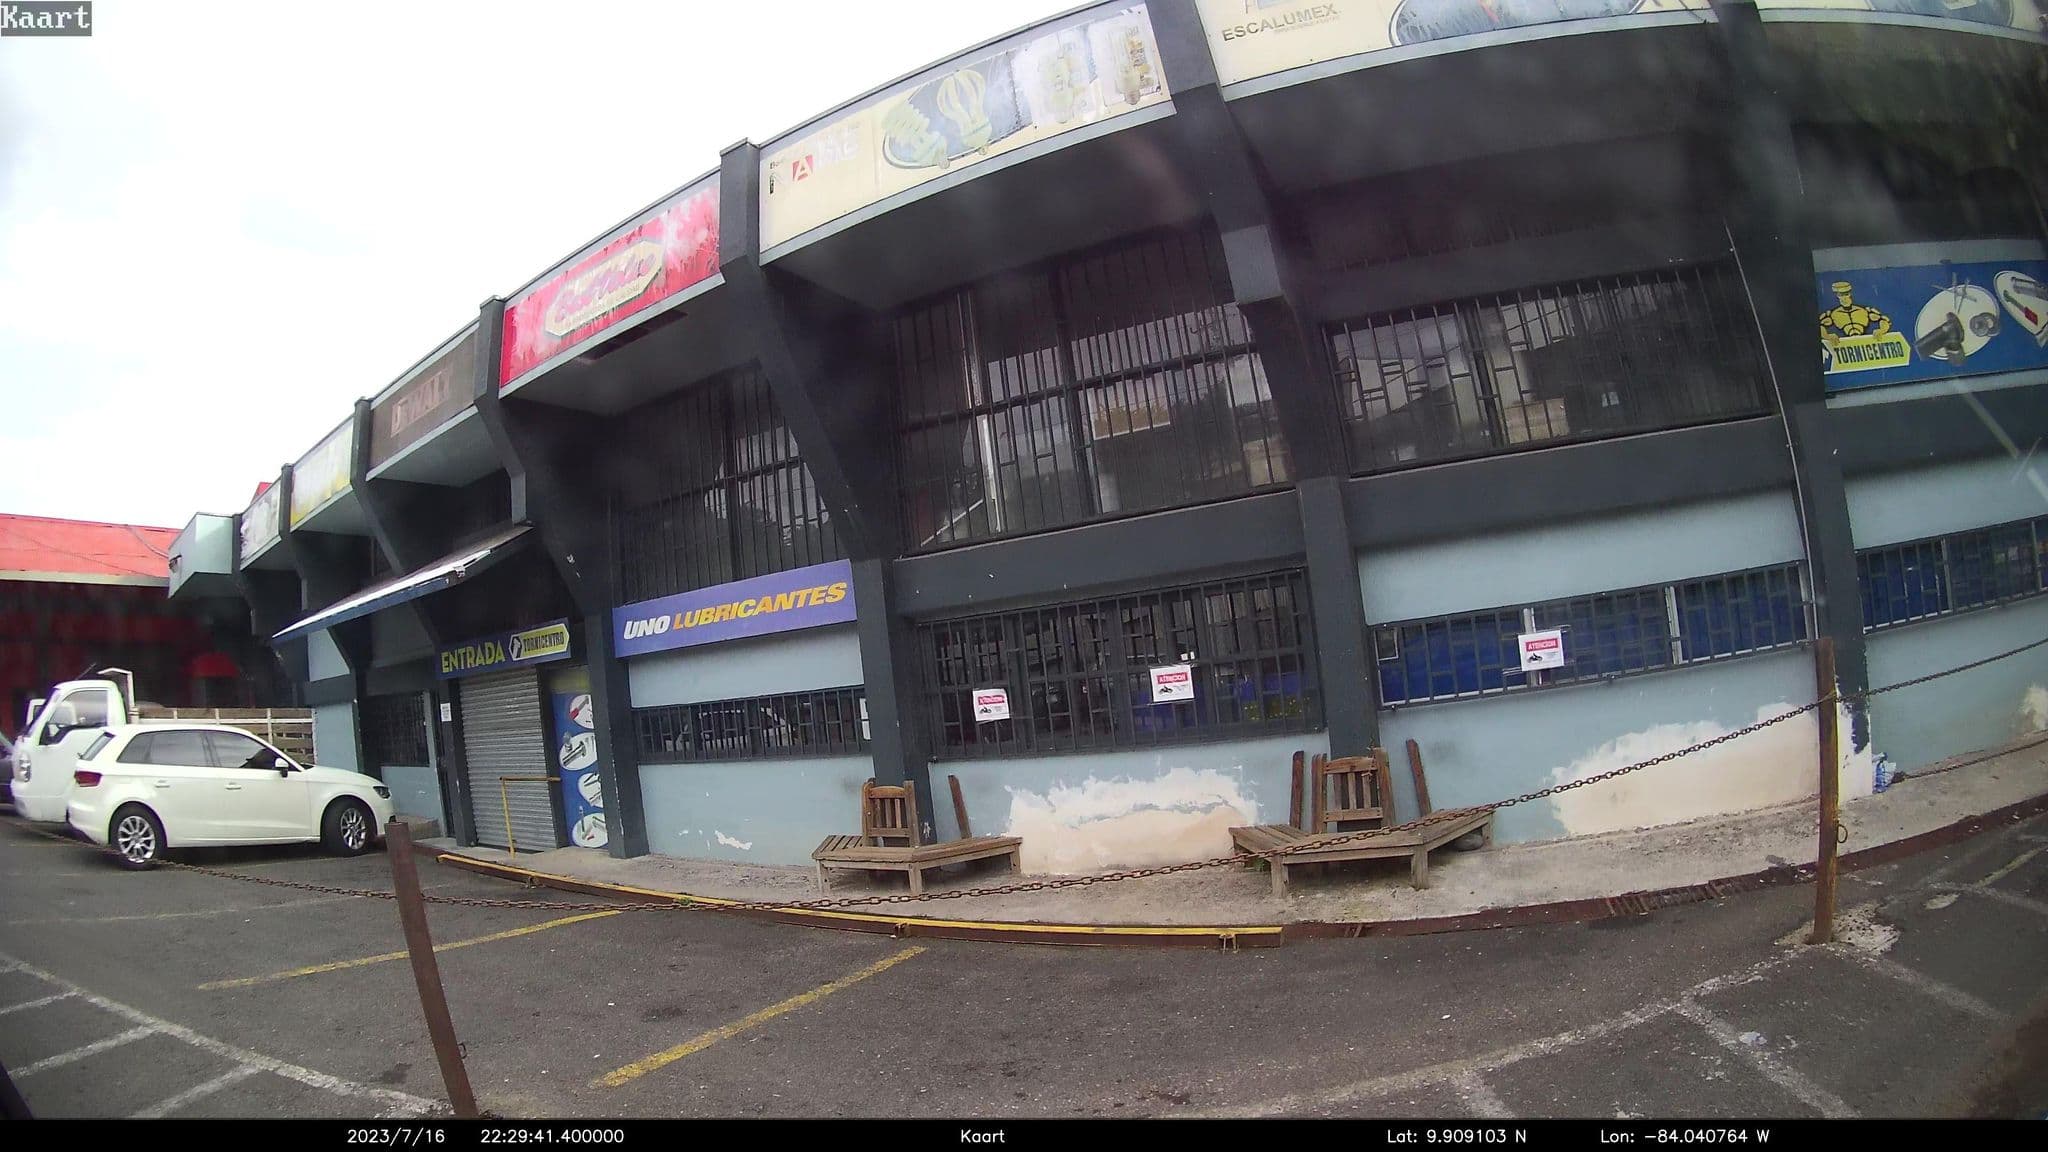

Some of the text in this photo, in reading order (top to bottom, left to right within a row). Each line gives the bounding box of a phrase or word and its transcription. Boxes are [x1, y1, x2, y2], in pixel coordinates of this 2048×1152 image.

[1221, 3, 1338, 42] ESCALUMEX
[1833, 341, 1904, 364] TORNICENTRO
[623, 582, 848, 640] UNO LUBRICANTES
[440, 639, 506, 673] ENTRADA
